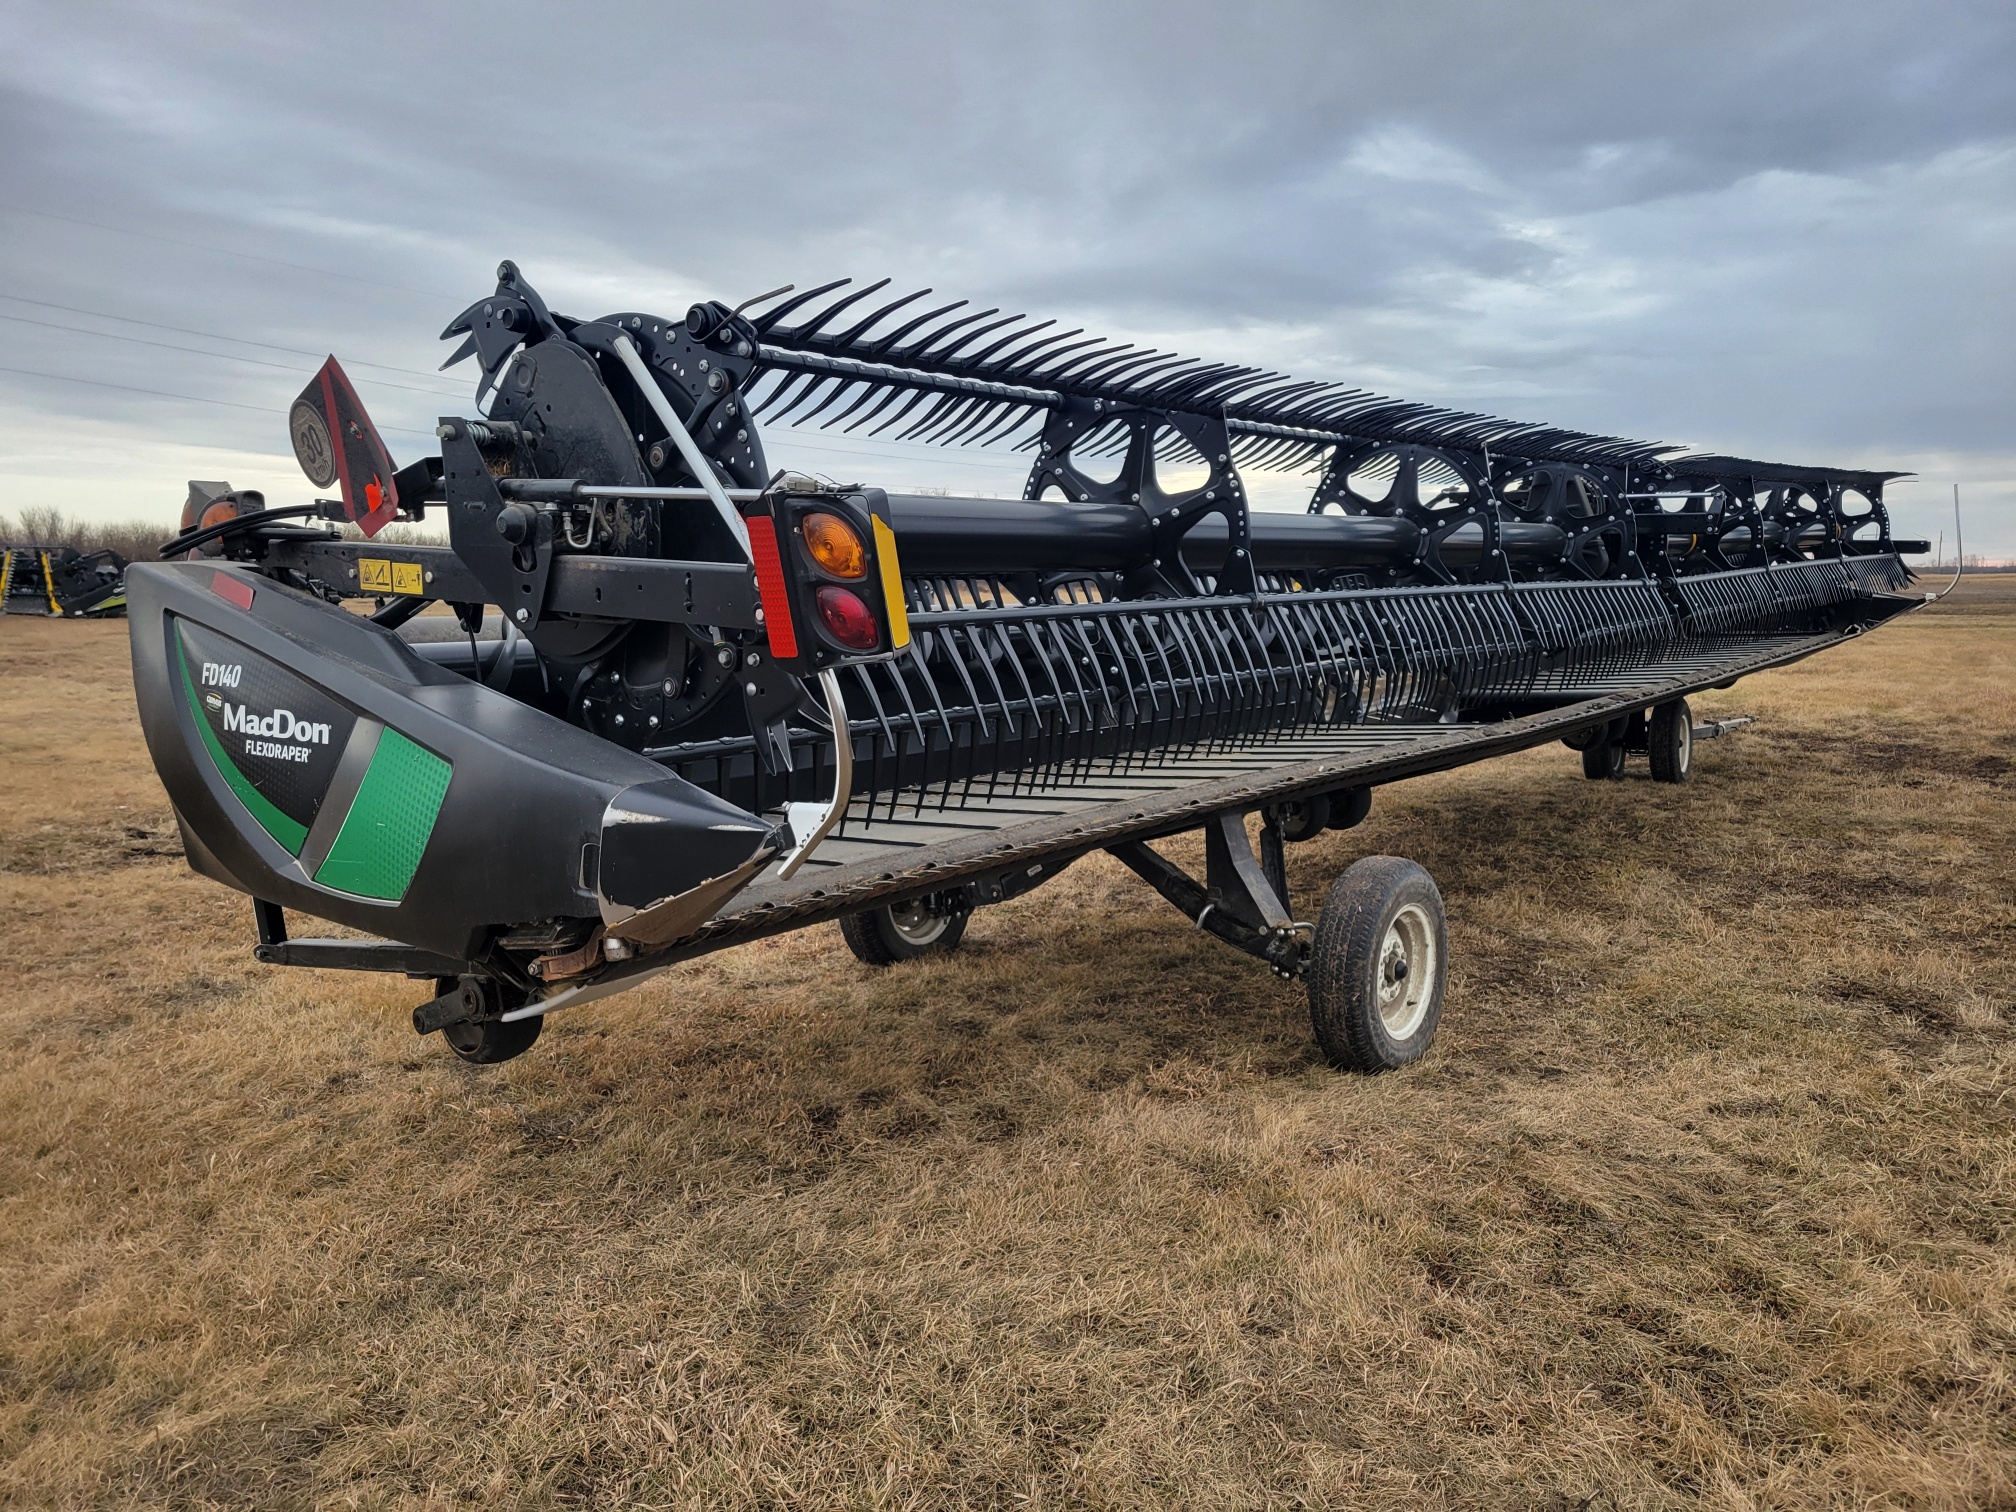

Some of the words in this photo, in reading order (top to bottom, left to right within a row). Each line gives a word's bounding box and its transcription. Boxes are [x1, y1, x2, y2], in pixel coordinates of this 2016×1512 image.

[301, 424, 323, 464] 30
[201, 662, 242, 688] FD140
[223, 702, 330, 745] MacDon
[245, 739, 309, 763] FLEXDRAPER
